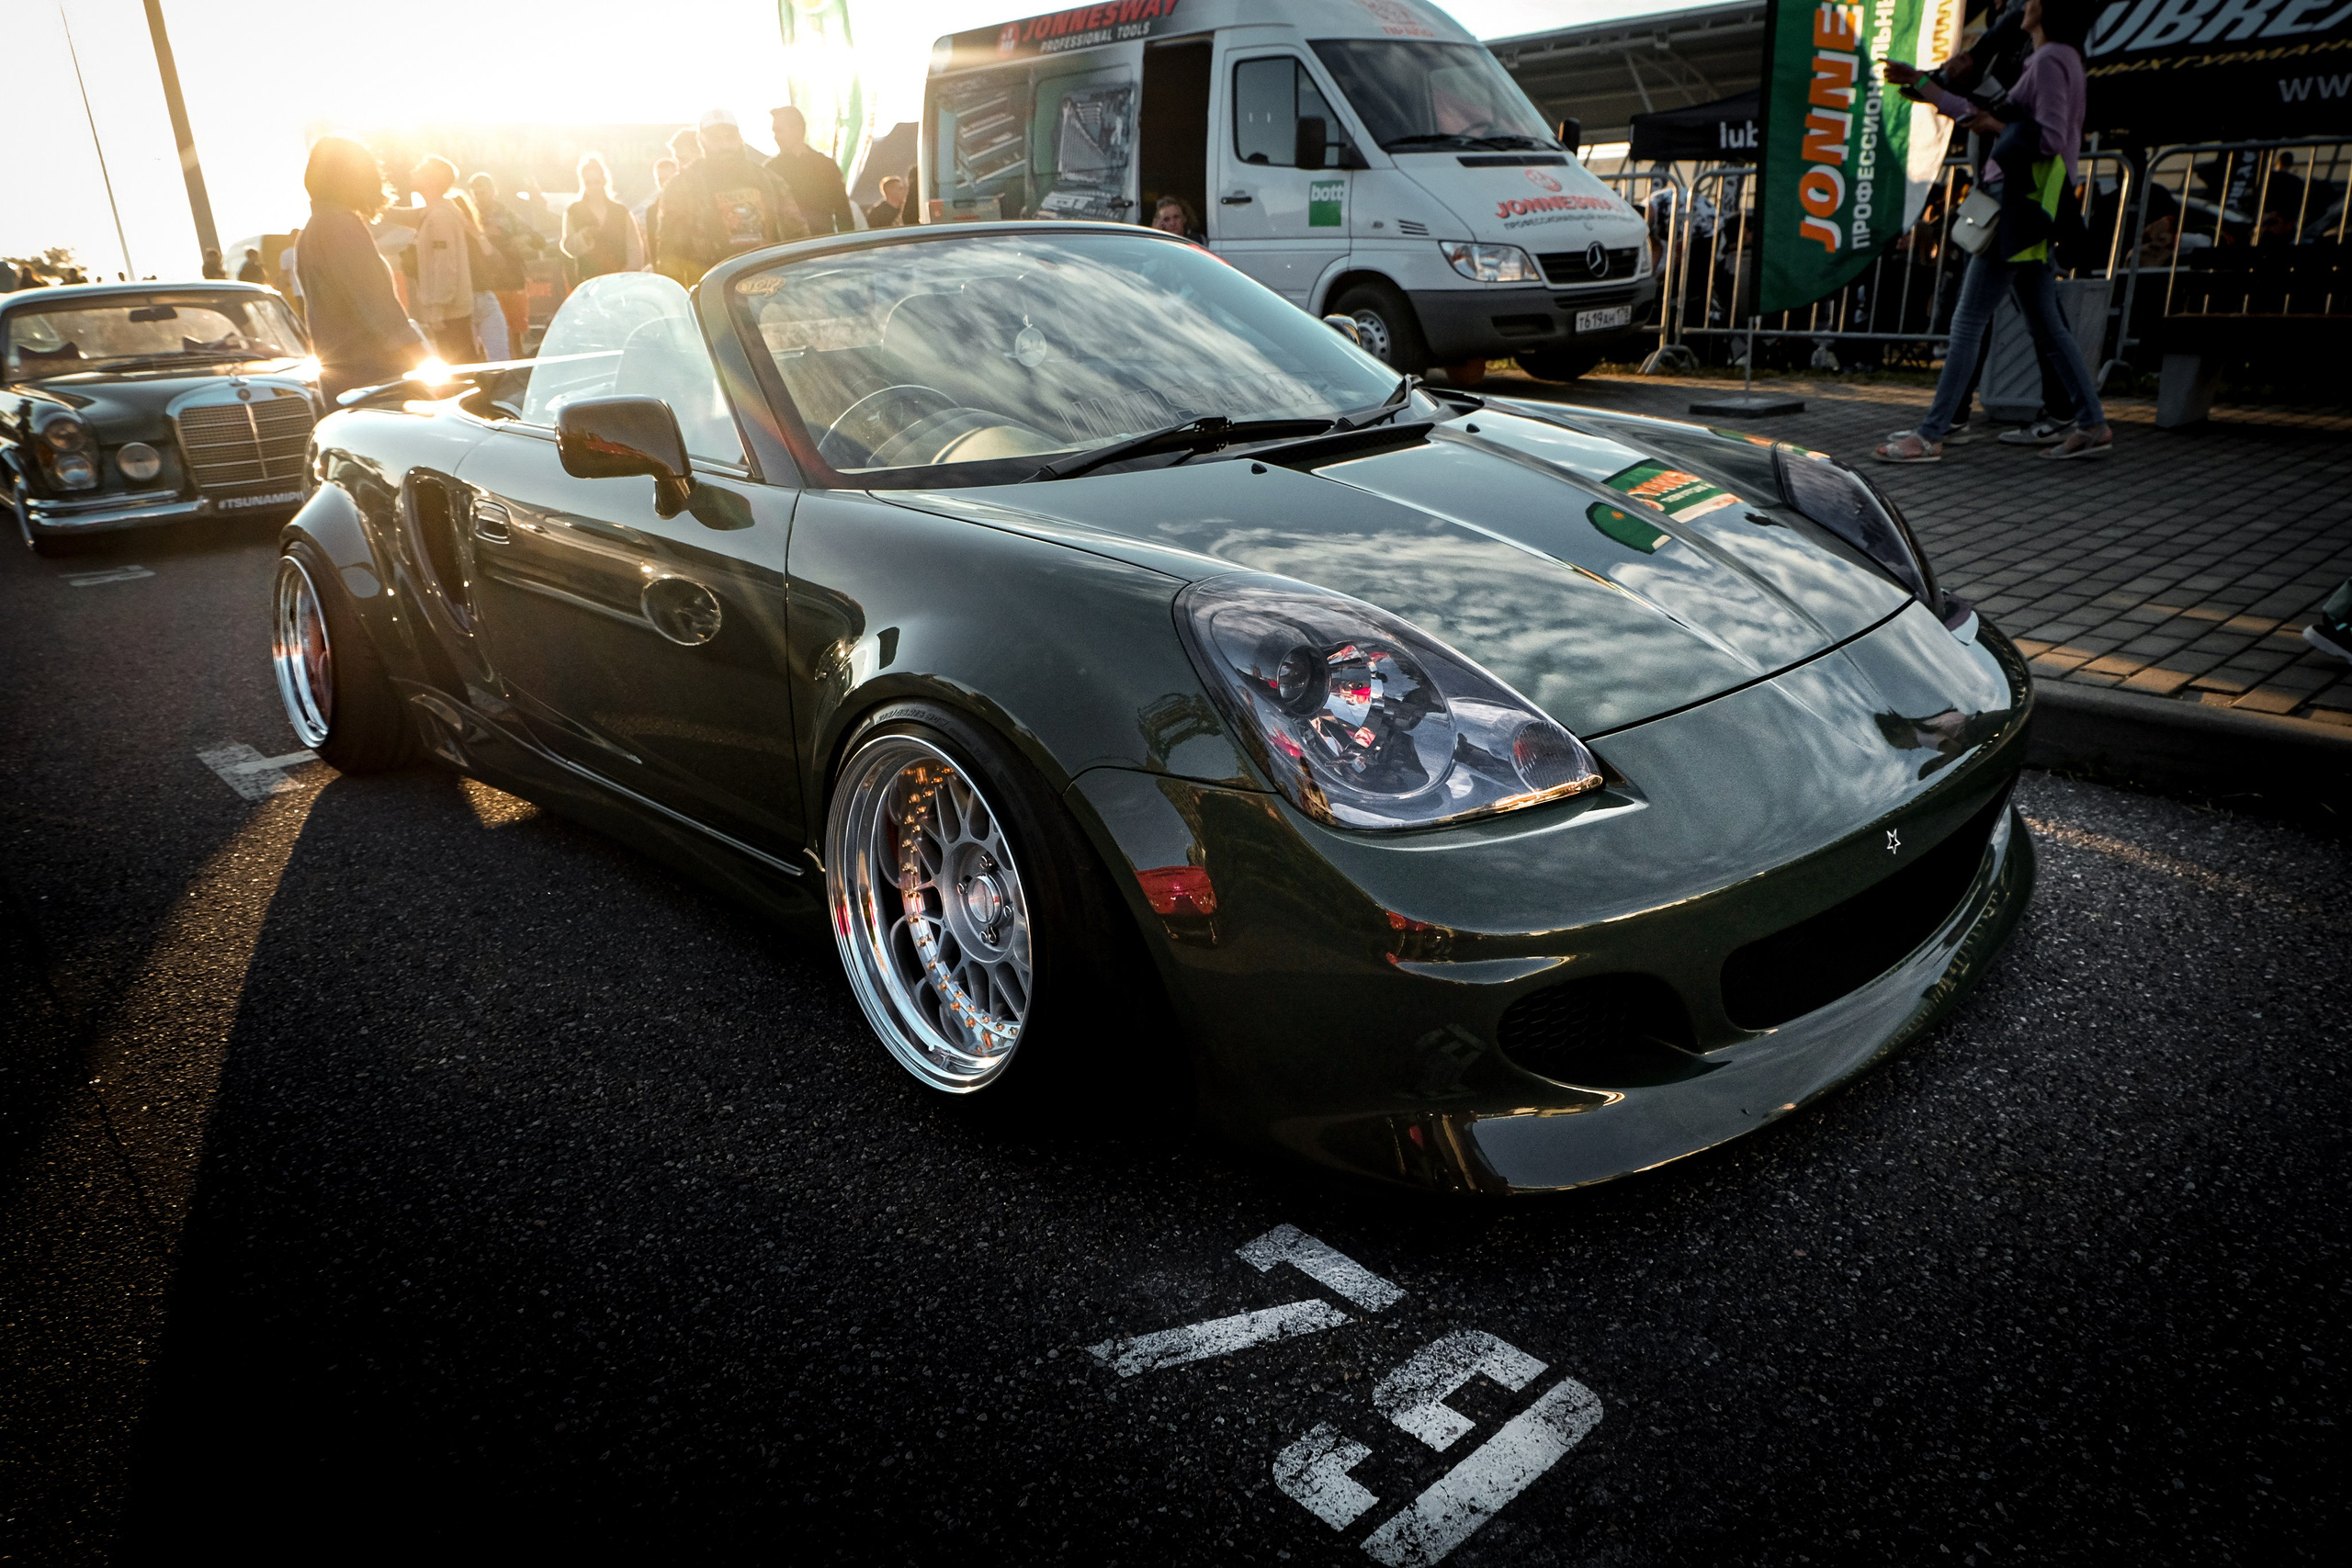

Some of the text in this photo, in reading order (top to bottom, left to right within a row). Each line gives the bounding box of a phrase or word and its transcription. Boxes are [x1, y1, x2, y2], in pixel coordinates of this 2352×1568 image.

[1023, 0, 1176, 42] JONNESWAY
[1040, 22, 1150, 53] PROFESSIONAL TOOLS
[1799, 0, 1864, 253] JONNE
[1851, 0, 1895, 250] ПРОФЕССИОНАЛЬН
[1311, 184, 1344, 202] bott
